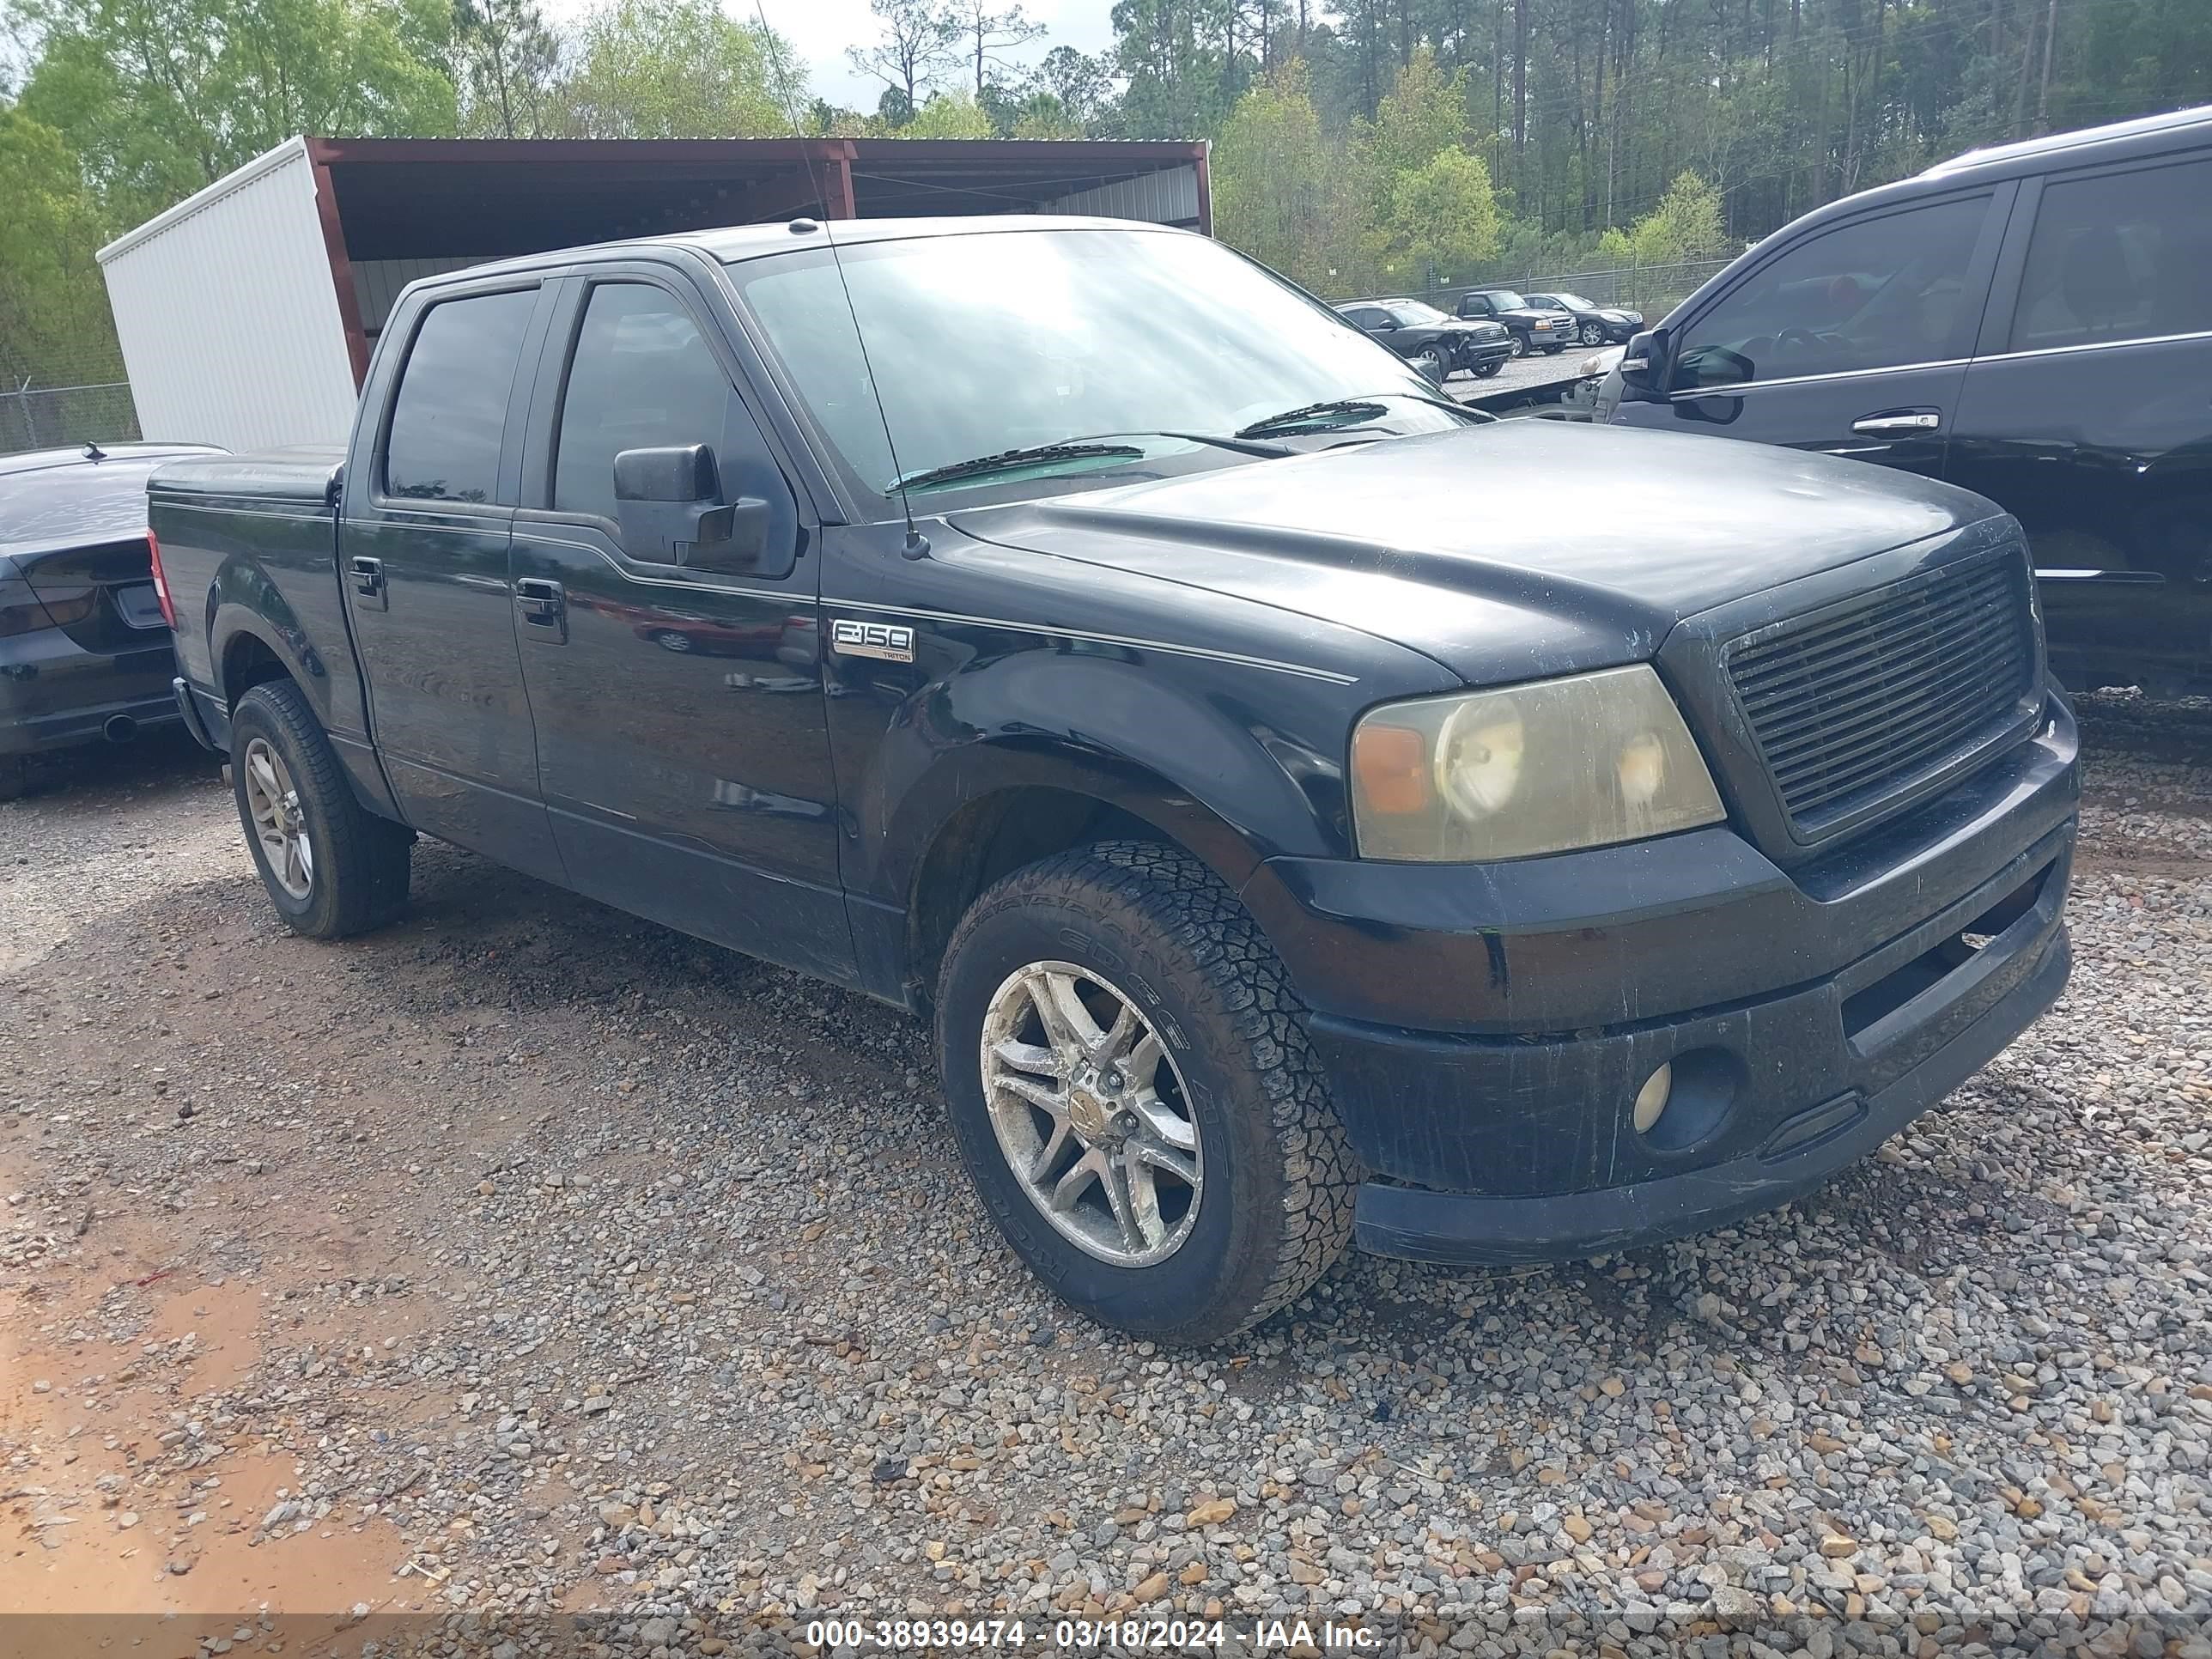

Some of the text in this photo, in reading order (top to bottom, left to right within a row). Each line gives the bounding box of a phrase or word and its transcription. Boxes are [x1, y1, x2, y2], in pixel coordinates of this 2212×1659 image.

[835, 622, 911, 650] F-150
[883, 652, 911, 661] TRITON
[1058, 926, 1192, 1051] EDGE
